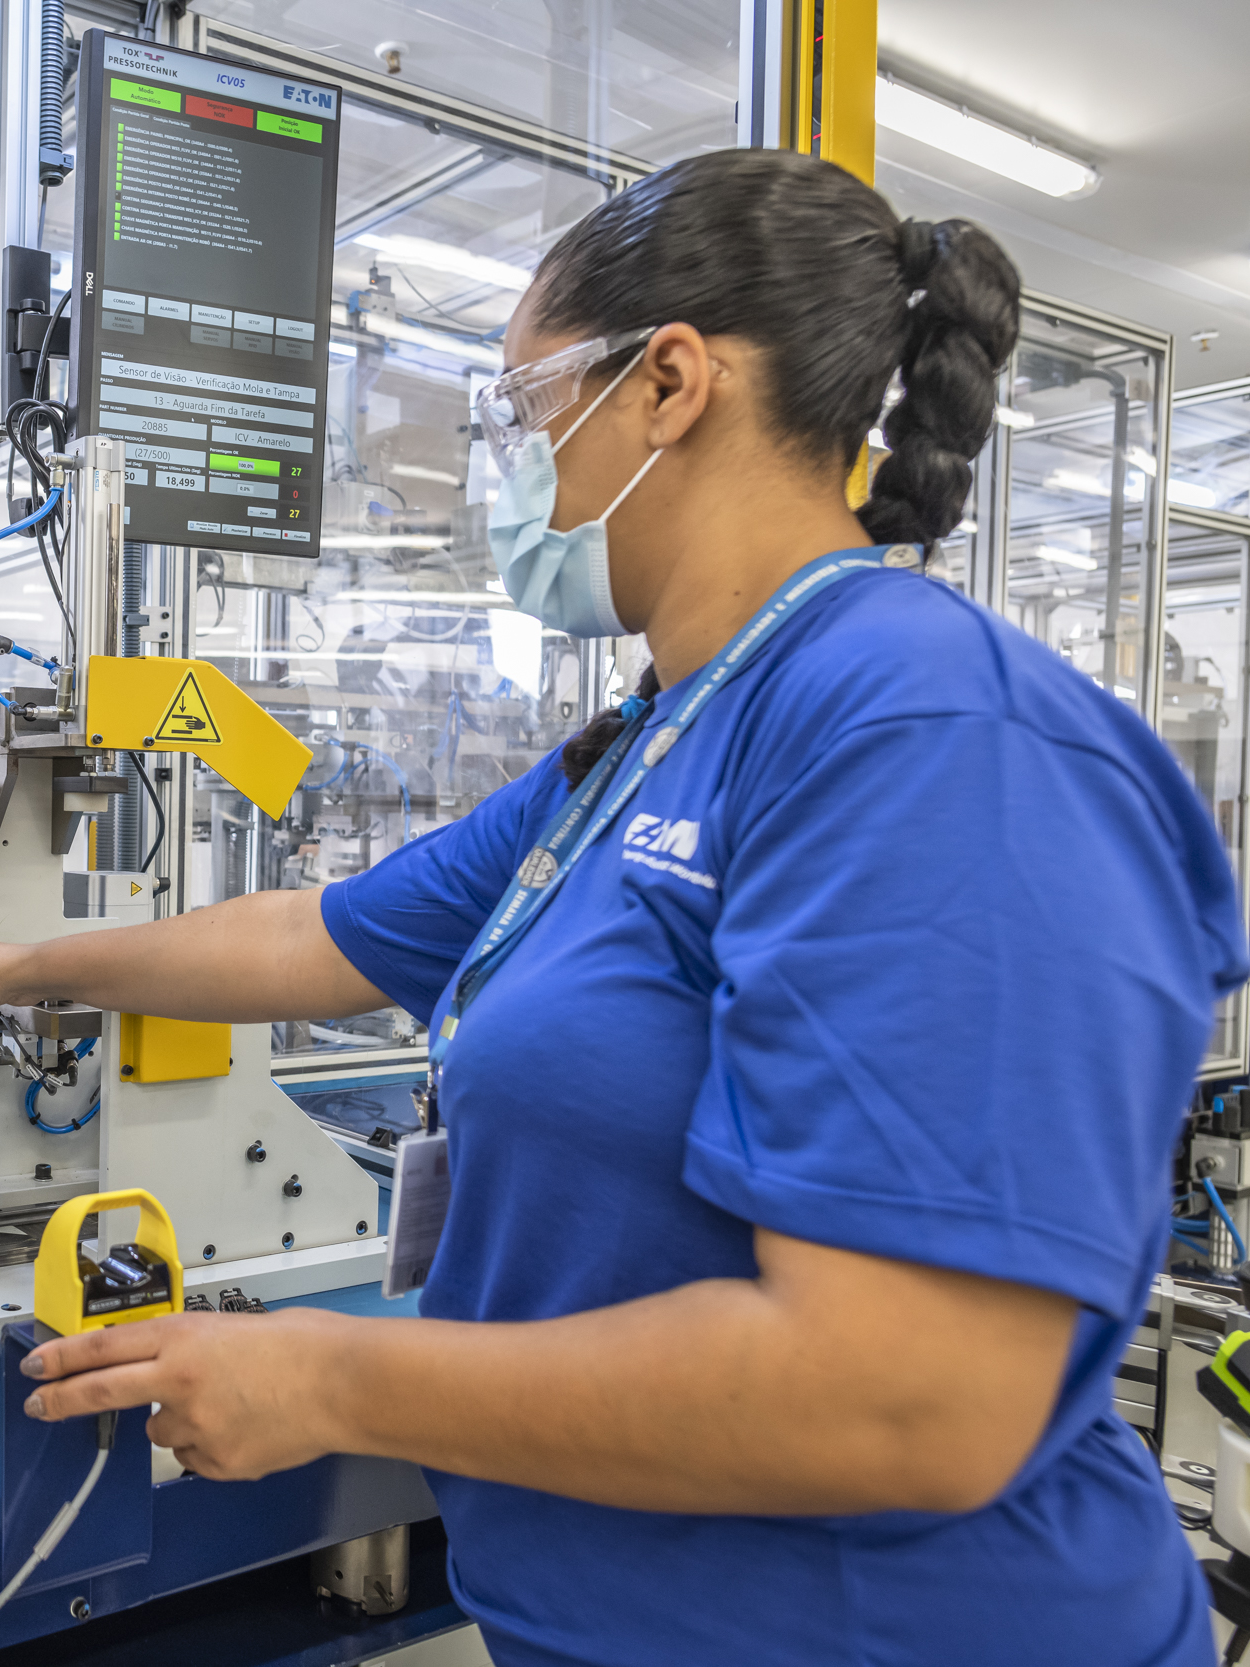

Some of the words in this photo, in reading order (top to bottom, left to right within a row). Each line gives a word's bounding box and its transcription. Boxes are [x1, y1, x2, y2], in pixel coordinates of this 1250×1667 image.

[109, 56, 178, 78] PRESSOTECHNIK
[217, 74, 245, 88] ICV05
[283, 85, 332, 109] EATON
[86, 272, 94, 296] DELL
[113, 298, 135, 306] COMANDO
[198, 312, 226, 320] MANUTENÇÃO
[101, 351, 124, 359] MENSAGEM
[119, 365, 148, 378] Sensor
[151, 370, 161, 379] de
[164, 372, 187, 383] Visão
[196, 376, 241, 391] Verificação
[243, 383, 263, 394] Mola
[273, 387, 300, 400] Tampa
[154, 397, 164, 405] 13
[173, 399, 208, 412] Aguarda
[211, 404, 226, 413] Fim
[228, 406, 238, 416] da
[241, 408, 265, 419] Tarefa
[142, 421, 168, 432] 20885
[235, 433, 249, 442] ICV
[257, 436, 291, 448] Amarelo
[135, 448, 171, 461] (27/500)
[291, 467, 302, 477] 27
[166, 476, 195, 487] 18,499
[293, 491, 298, 499] 0
[289, 509, 300, 518] 27
[499, 889, 529, 926] SEMANA
[489, 927, 504, 941] DA
